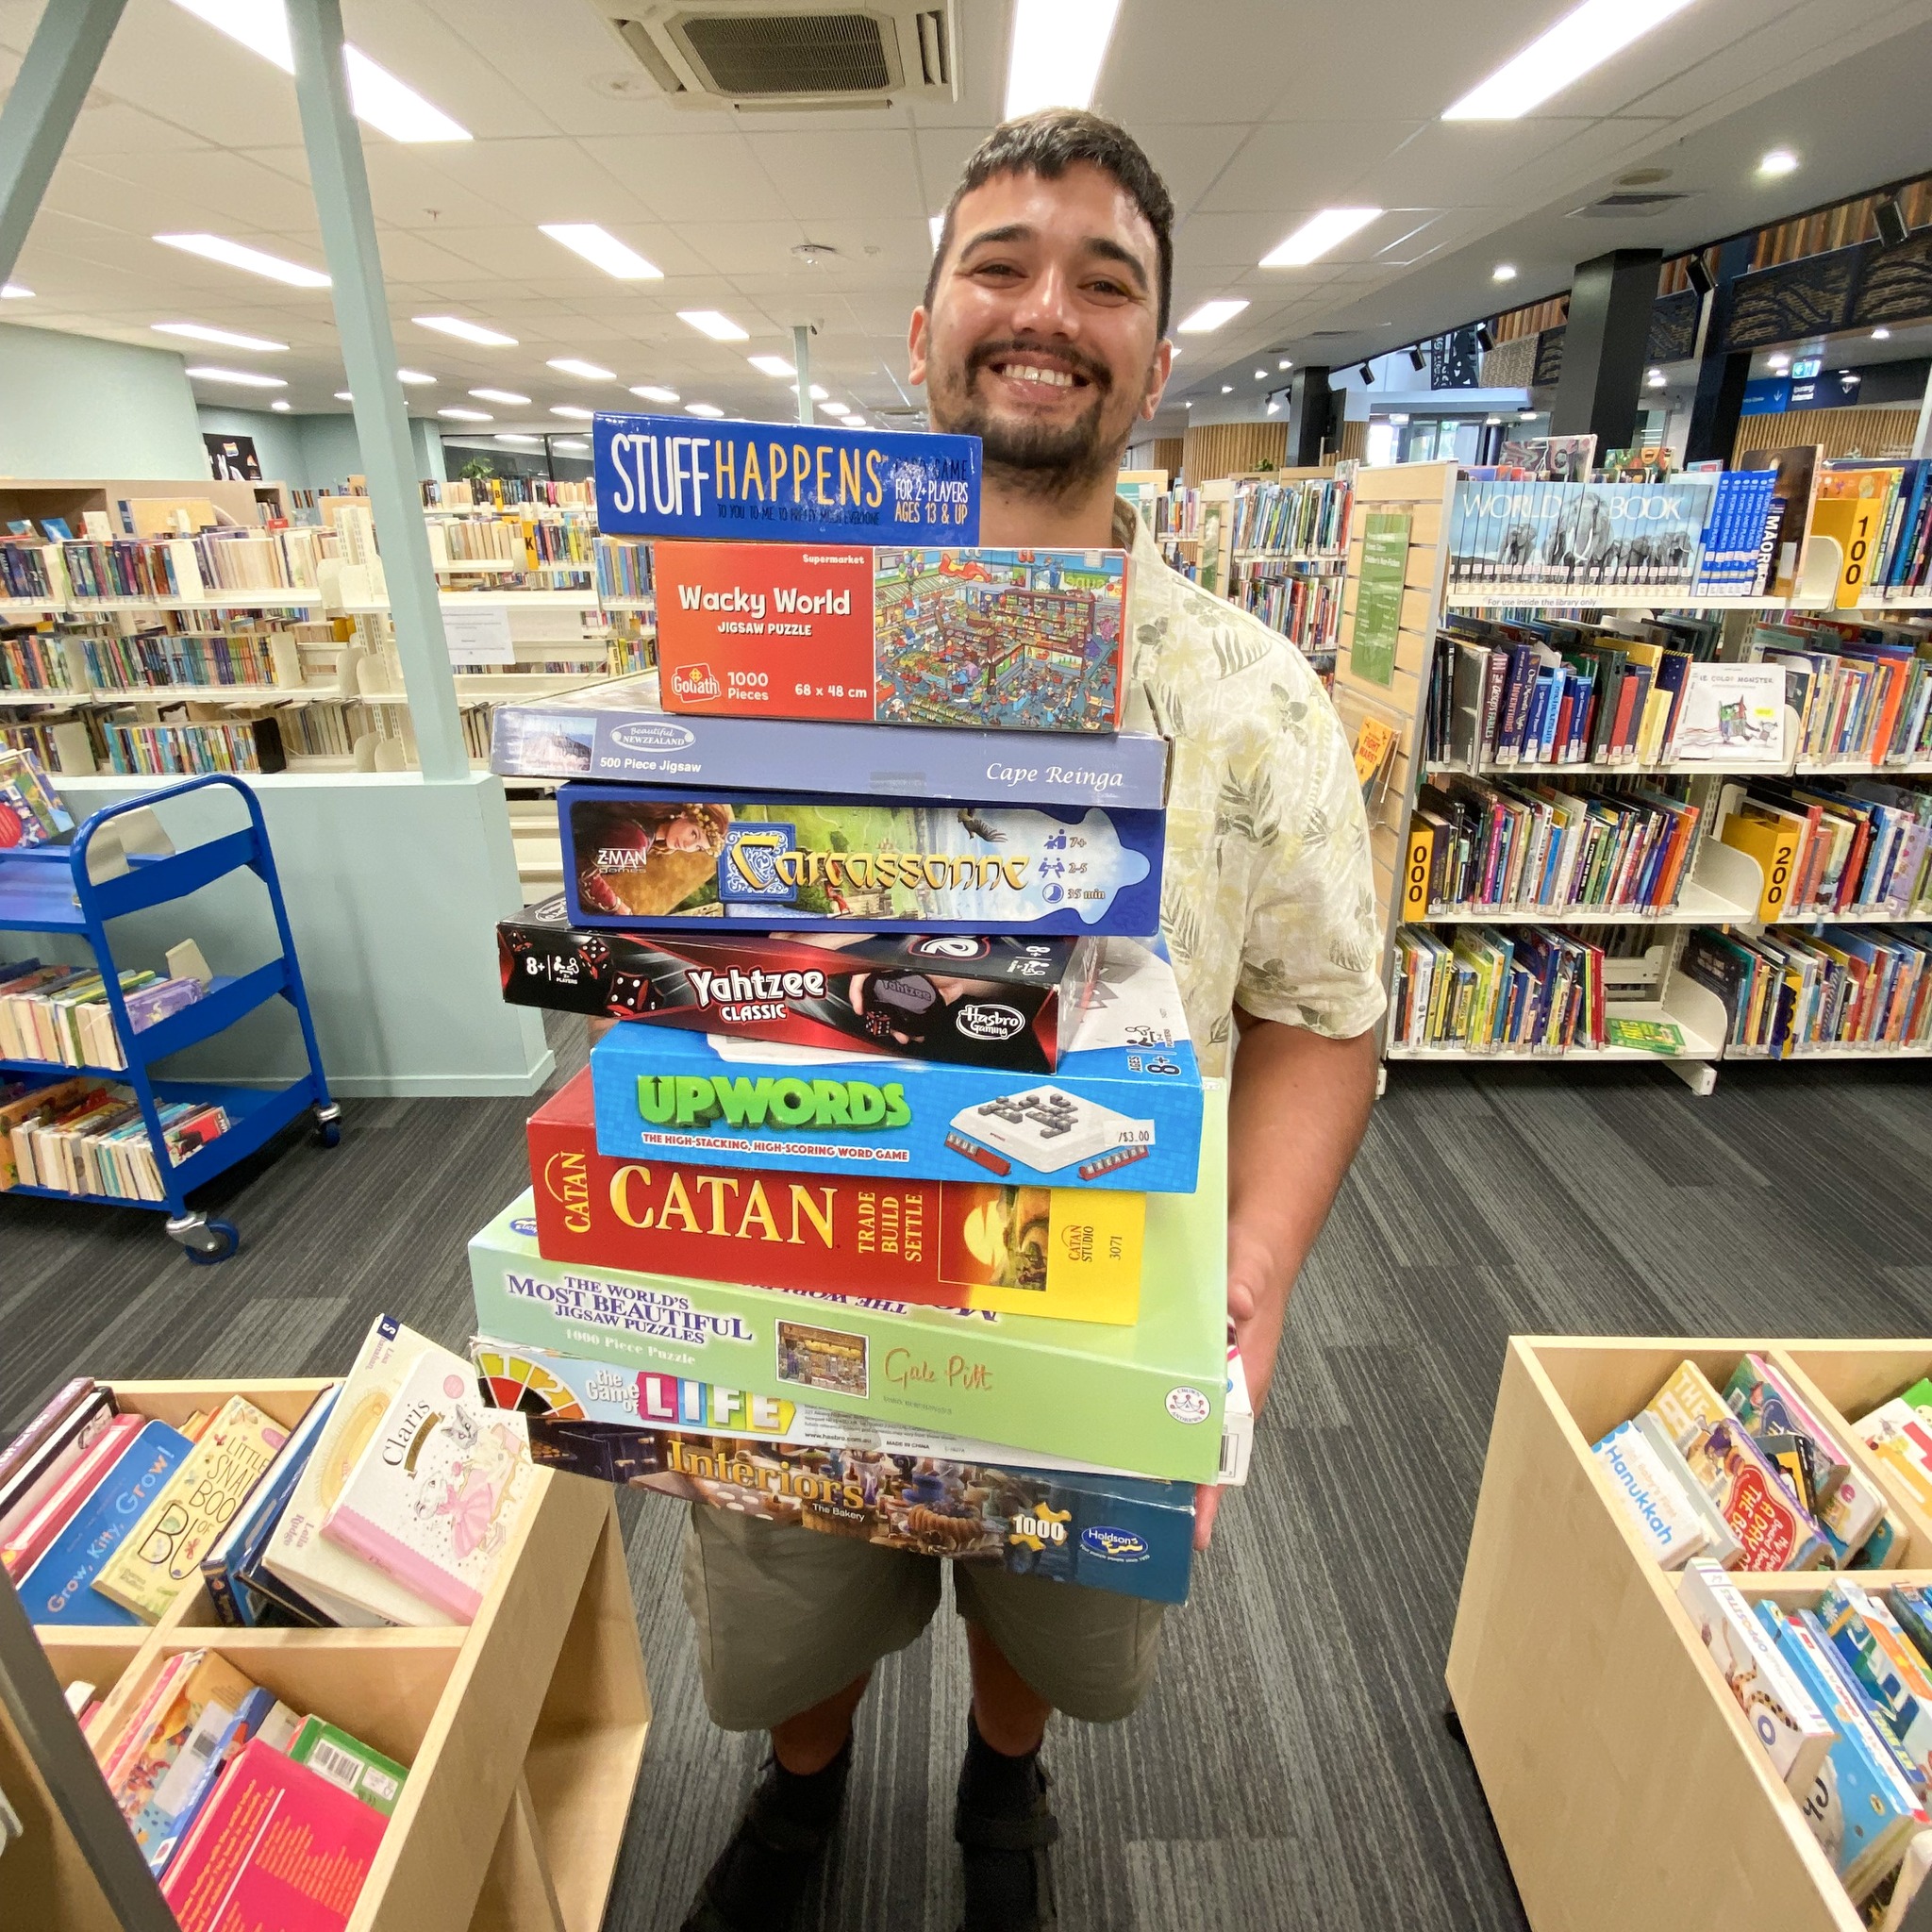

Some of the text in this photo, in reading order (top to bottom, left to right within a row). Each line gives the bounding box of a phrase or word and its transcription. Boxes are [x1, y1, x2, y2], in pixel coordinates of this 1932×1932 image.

[611, 432, 883, 517] STUFF HAPPENS
[895, 479, 968, 504] FOR 2+ PLAYERS
[894, 501, 969, 525] AGES 13 & UP
[1463, 493, 1685, 520] WORLD BOOK
[525, 537, 534, 551] K
[1845, 515, 1869, 585] 100
[803, 554, 865, 565] Supermarket
[677, 584, 852, 619] Wacky World
[1517, 597, 1540, 607] inside
[1541, 598, 1554, 607] the
[1557, 598, 1579, 608] library
[1581, 599, 1596, 608] only
[718, 621, 812, 636] JIGSAW PUZZLE
[674, 675, 719, 695] Goliath
[727, 672, 769, 687] 1000
[795, 683, 867, 698] 68 x 48 cm
[727, 688, 769, 701] Pieces
[623, 735, 686, 746] NEWZEALAND
[630, 726, 675, 738] Beautiful
[600, 758, 702, 774] 500 Piece Jigsaw
[986, 761, 1124, 791] Cape Reinga
[1070, 836, 1087, 848] 7+
[597, 849, 647, 869] Z-MAN
[731, 835, 1031, 891] Carcassonne
[1069, 862, 1088, 874] 2-5
[1408, 845, 1427, 903] 000
[1768, 846, 1791, 904] 200
[1083, 889, 1106, 899] min
[525, 957, 545, 975] 8+
[687, 969, 933, 1008] Yahtzee Yahtzee
[721, 1003, 787, 1022] CLASSIC
[961, 1006, 1019, 1027] Hasbro
[970, 1021, 1008, 1037] Gaming
[1128, 1056, 1142, 1072] AGES
[1146, 1056, 1181, 1075] 8+
[638, 1074, 912, 1127] UPWORDS
[643, 1133, 908, 1161] THE HIGH-STACKING, HIGH-SCORING WORD GAME
[560, 1151, 591, 1234] CATAN
[609, 1165, 839, 1249] CATAN
[858, 1191, 876, 1254] TRADE
[881, 1196, 900, 1255] BUILD
[905, 1193, 923, 1263] SETTLE
[1068, 1224, 1083, 1260] CATAN
[1082, 1225, 1094, 1262] STUDIO
[1109, 1235, 1123, 1260] 3071
[564, 1275, 689, 1310] THE WORLD'S
[507, 1274, 753, 1341] MOST BEAUTIFUL
[381, 1323, 397, 1336] S
[555, 1304, 705, 1344] JIGSAW PUZZLES
[382, 1347, 395, 1365] Lisa
[566, 1328, 696, 1365] 1000 Piece Puzzle
[498, 1355, 510, 1378] 1
[595, 1370, 623, 1387] the
[884, 1347, 935, 1390] Gale
[538, 1372, 565, 1404] 2
[1674, 1371, 1711, 1421] THE
[585, 1379, 640, 1403] Game
[646, 1377, 780, 1428] LIFE
[623, 1398, 640, 1415] of
[382, 1400, 431, 1466] Claris
[804, 1432, 872, 1444] www.hasbro.com.au
[225, 1437, 271, 1474] LITTLE
[667, 1440, 865, 1509] Interiors
[1605, 1444, 1673, 1545] Hanukkah
[1739, 1484, 1762, 1519] THE
[812, 1503, 865, 1523] The Bakery
[47, 1563, 94, 1613] Grow,
[86, 1523, 125, 1560] Kitty,
[116, 1445, 175, 1514] Grow!
[197, 1520, 215, 1536] OF
[283, 1513, 305, 1547] Rudge
[1013, 1514, 1065, 1541] 1000
[1748, 1501, 1775, 1553] A DAY
[1774, 1536, 1789, 1554] My
[1721, 1589, 1768, 1653] OPPOSITES
